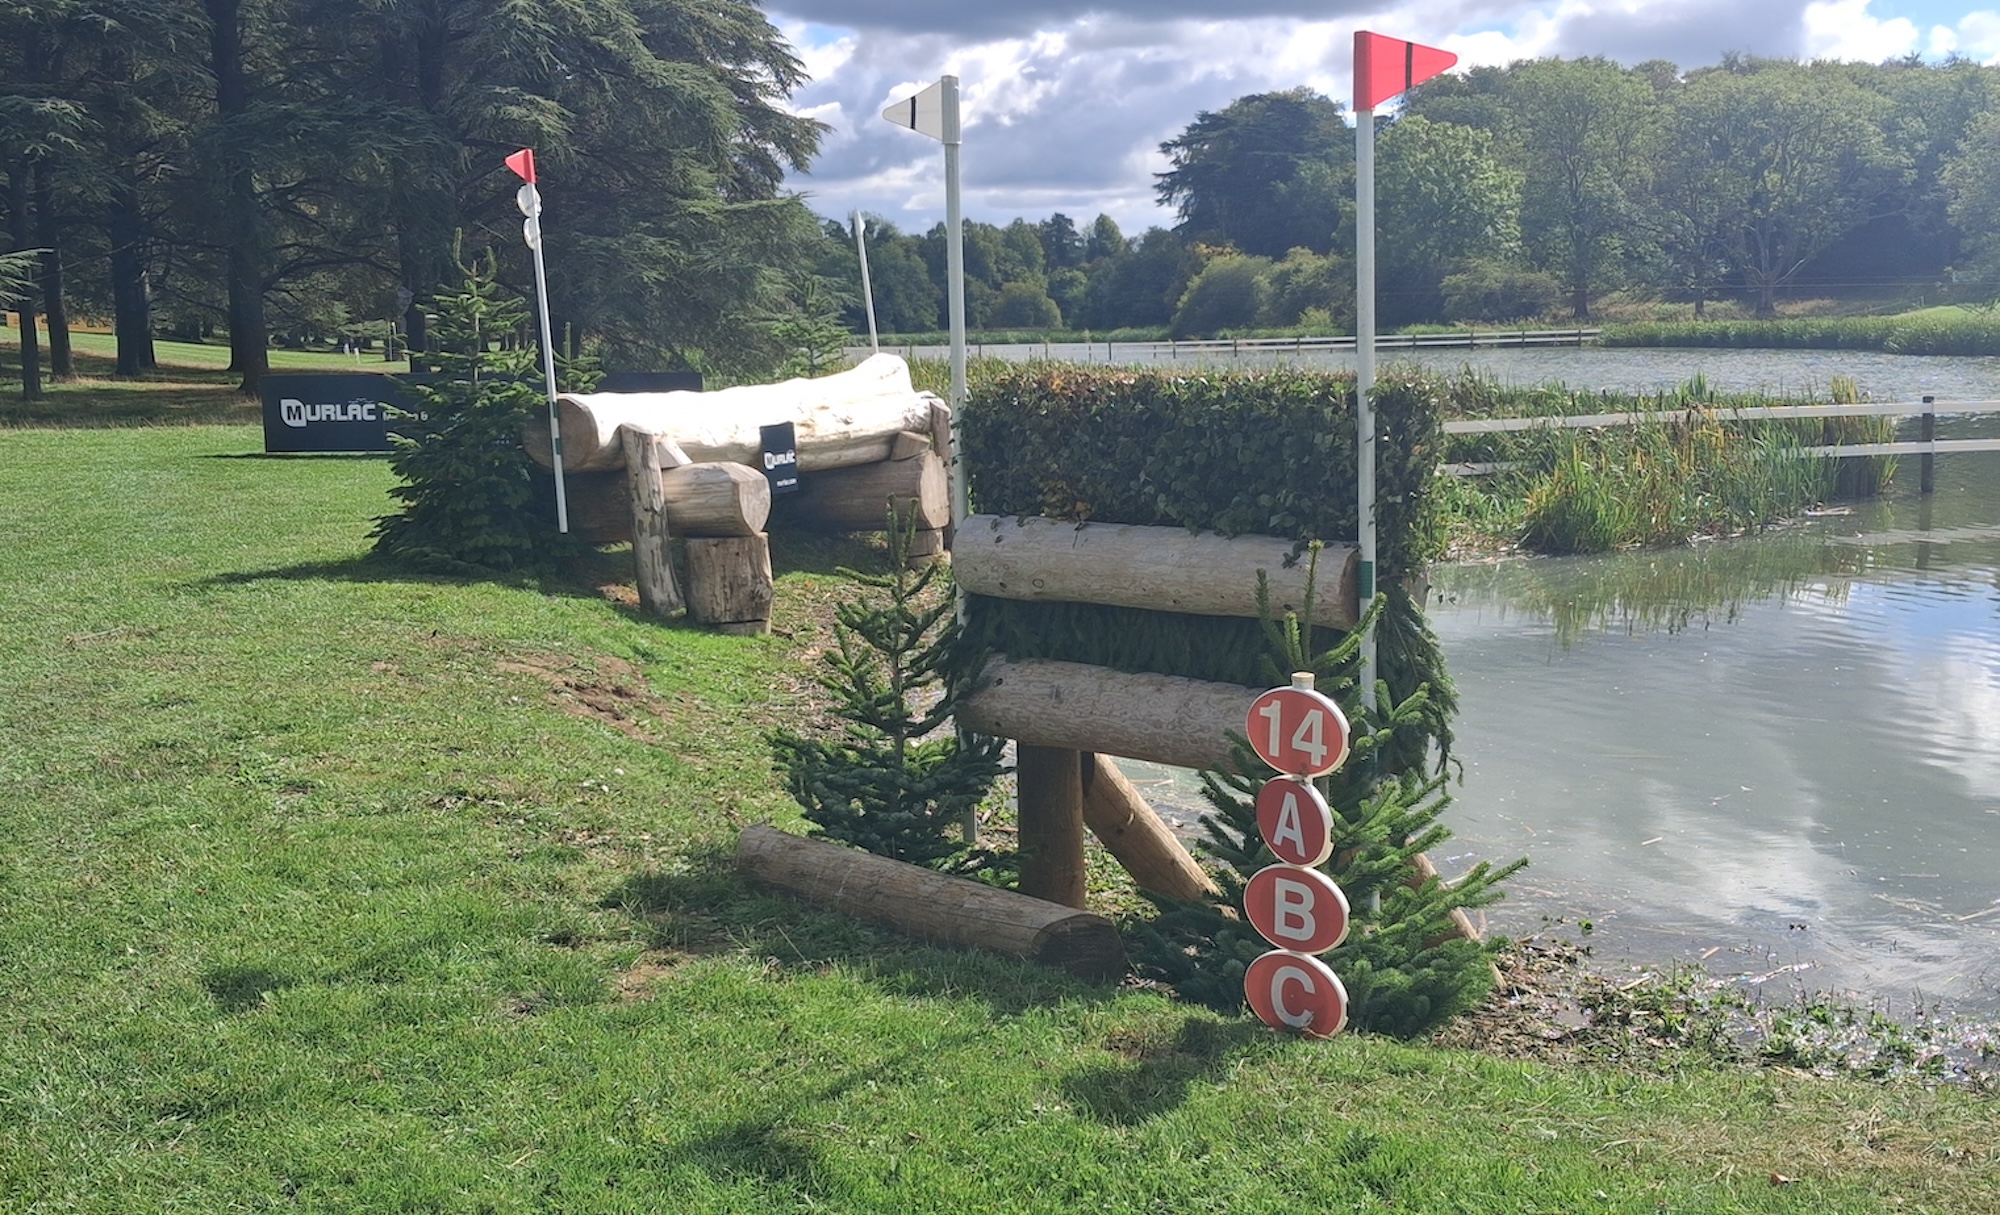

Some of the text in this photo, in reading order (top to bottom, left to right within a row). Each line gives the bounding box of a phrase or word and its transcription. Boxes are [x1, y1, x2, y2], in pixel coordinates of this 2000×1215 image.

[280, 398, 376, 427] MURLAC
[1259, 699, 1328, 767] 14
[1272, 791, 1306, 858] A
[1274, 877, 1316, 941] B
[1270, 965, 1315, 1029] C
